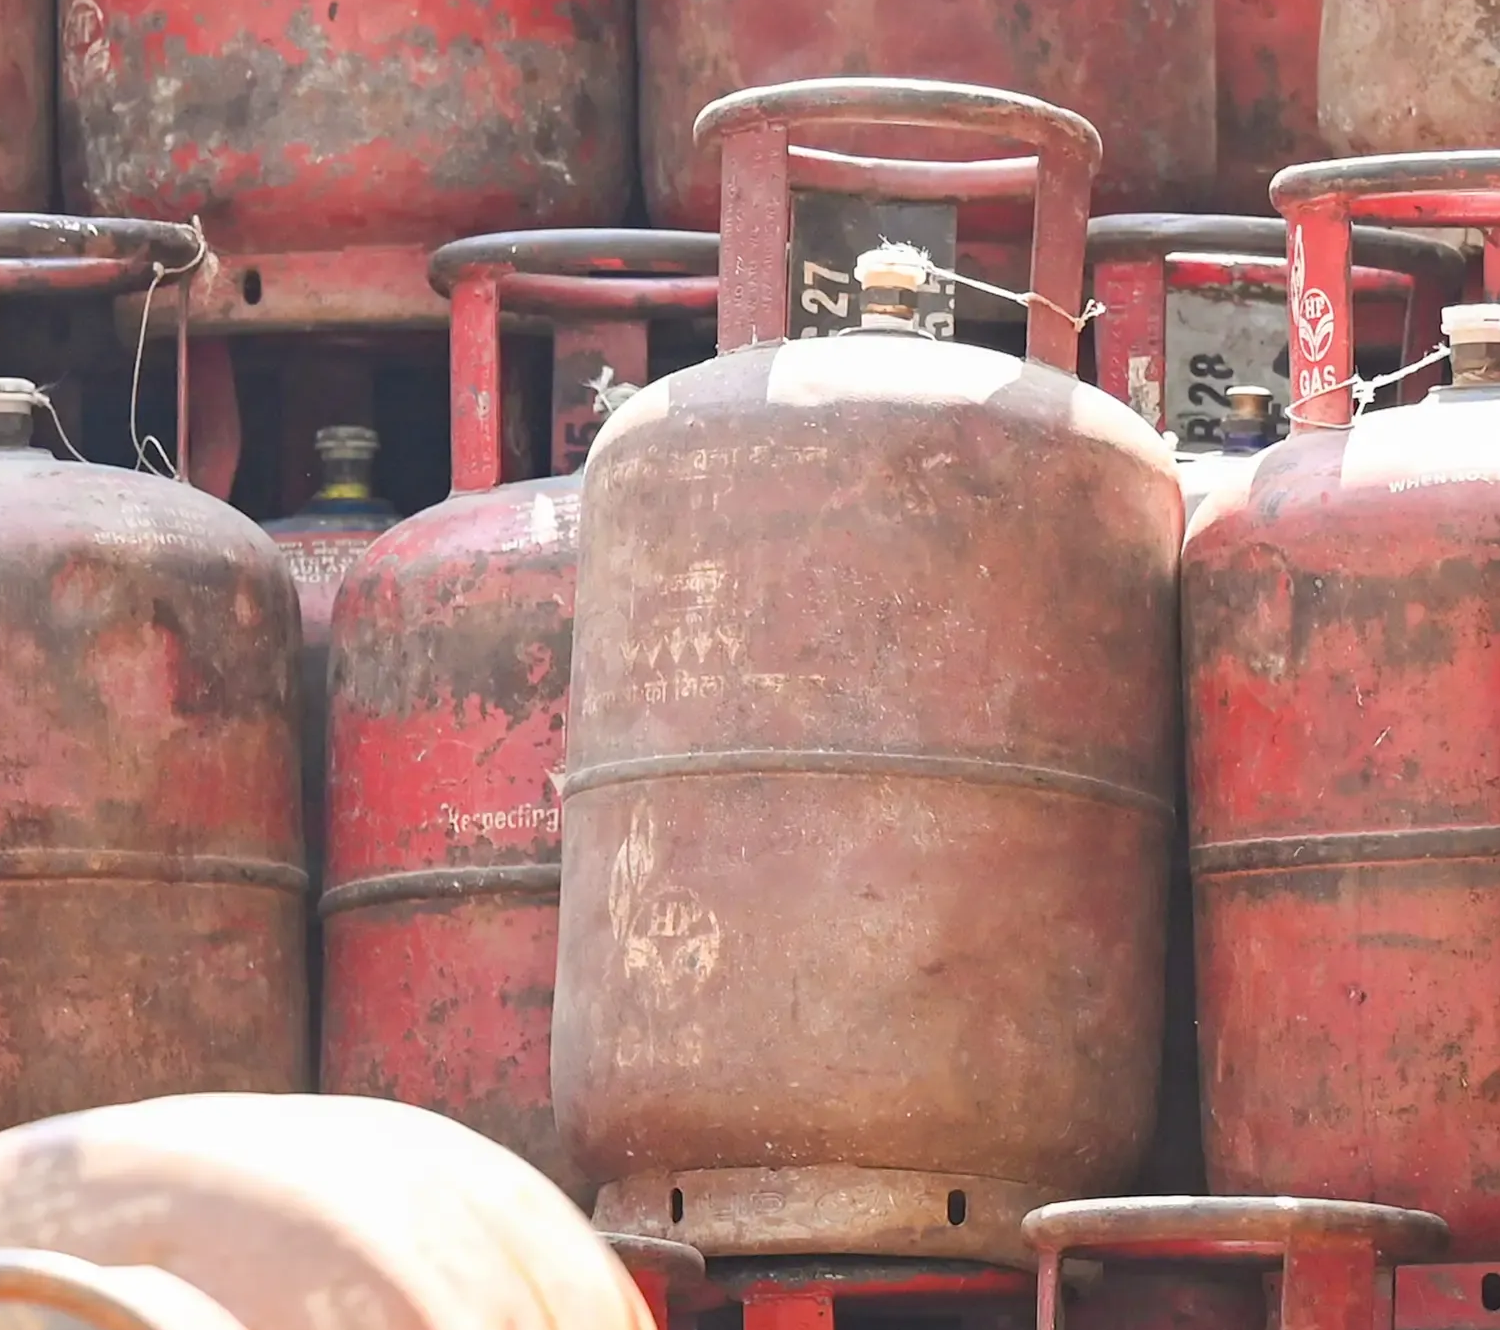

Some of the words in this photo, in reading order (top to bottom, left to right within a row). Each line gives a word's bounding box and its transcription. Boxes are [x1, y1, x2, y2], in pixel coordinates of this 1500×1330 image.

[1304, 295, 1326, 320] HP
[1299, 365, 1337, 398] GAS
[1388, 472, 1448, 494] WHEN
